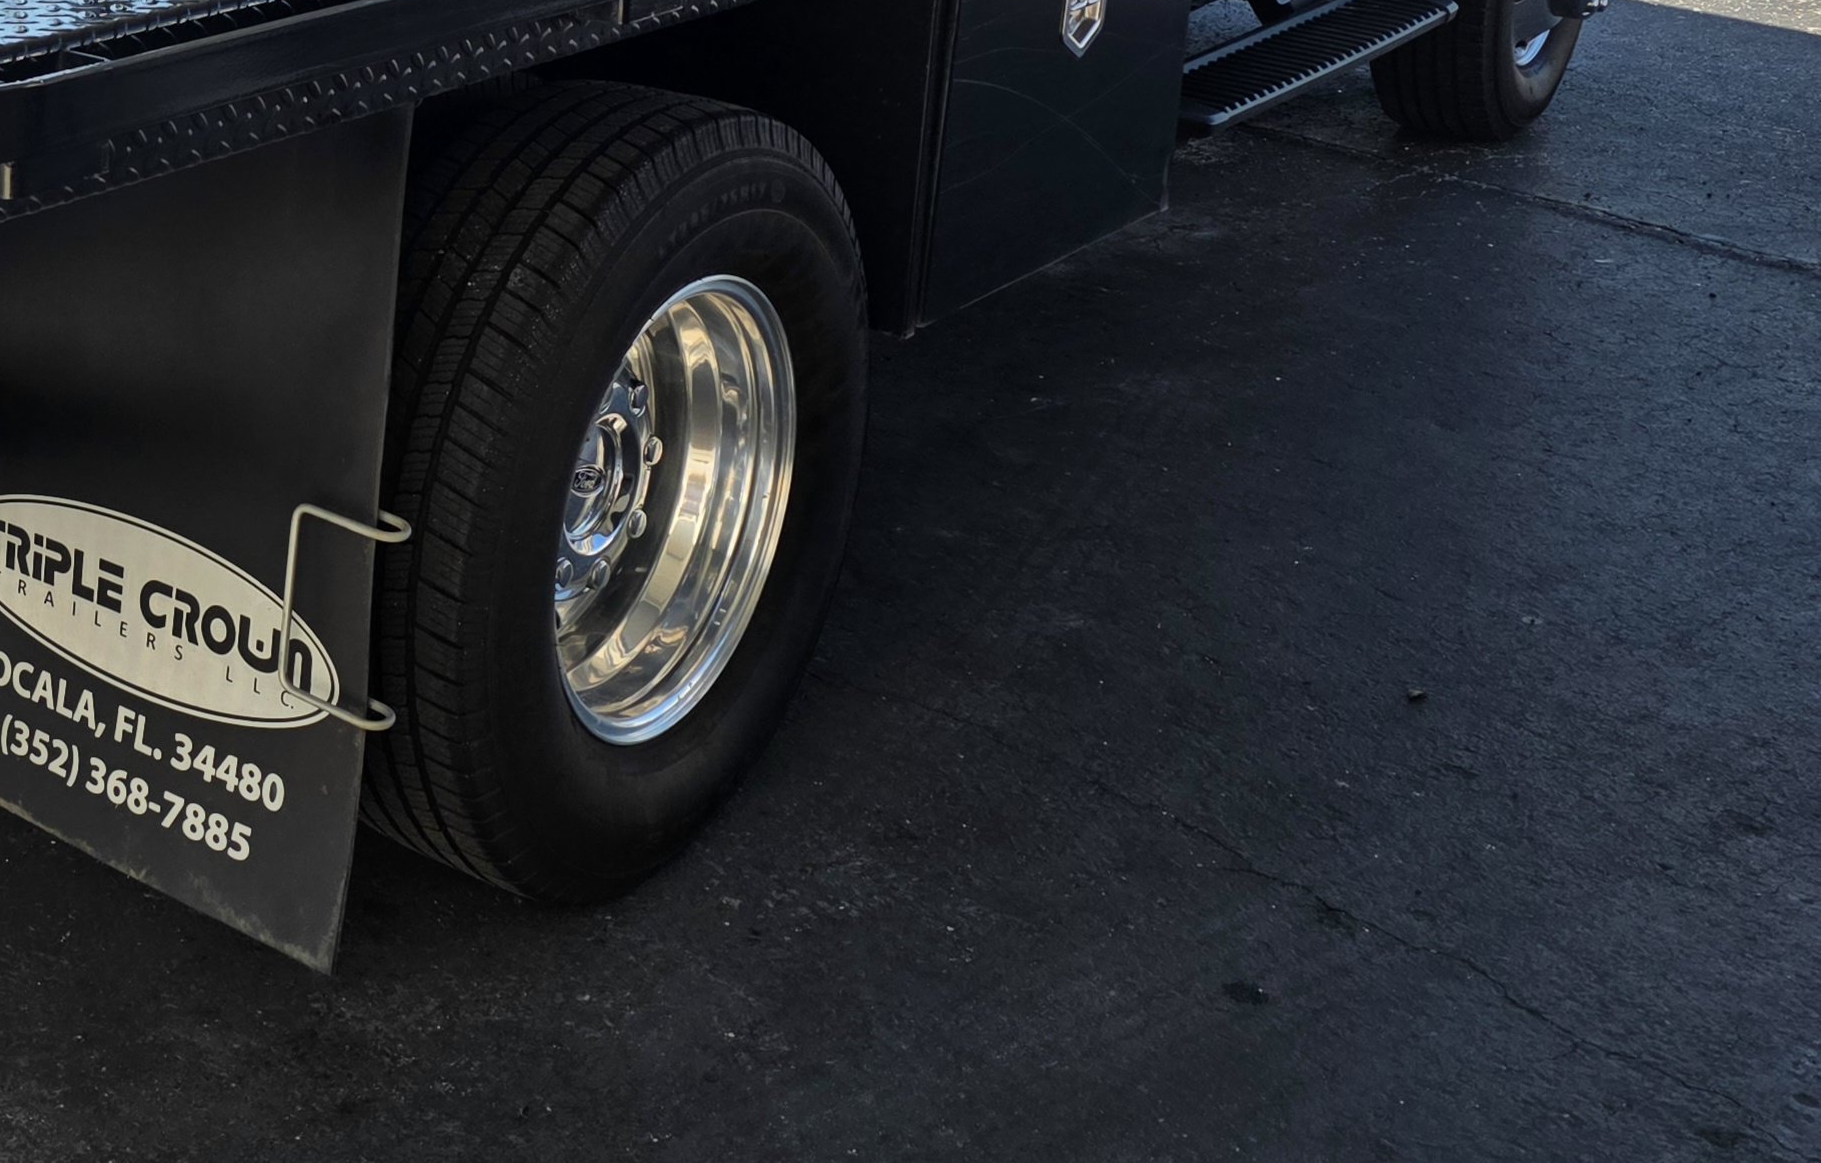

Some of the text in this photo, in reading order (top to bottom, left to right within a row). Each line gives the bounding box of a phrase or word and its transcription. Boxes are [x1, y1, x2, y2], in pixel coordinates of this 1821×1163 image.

[139, 579, 314, 696] CROWN
[0, 713, 253, 862] (352) 368-7885
[113, 704, 163, 760] FL.
[169, 733, 286, 813] 34480
